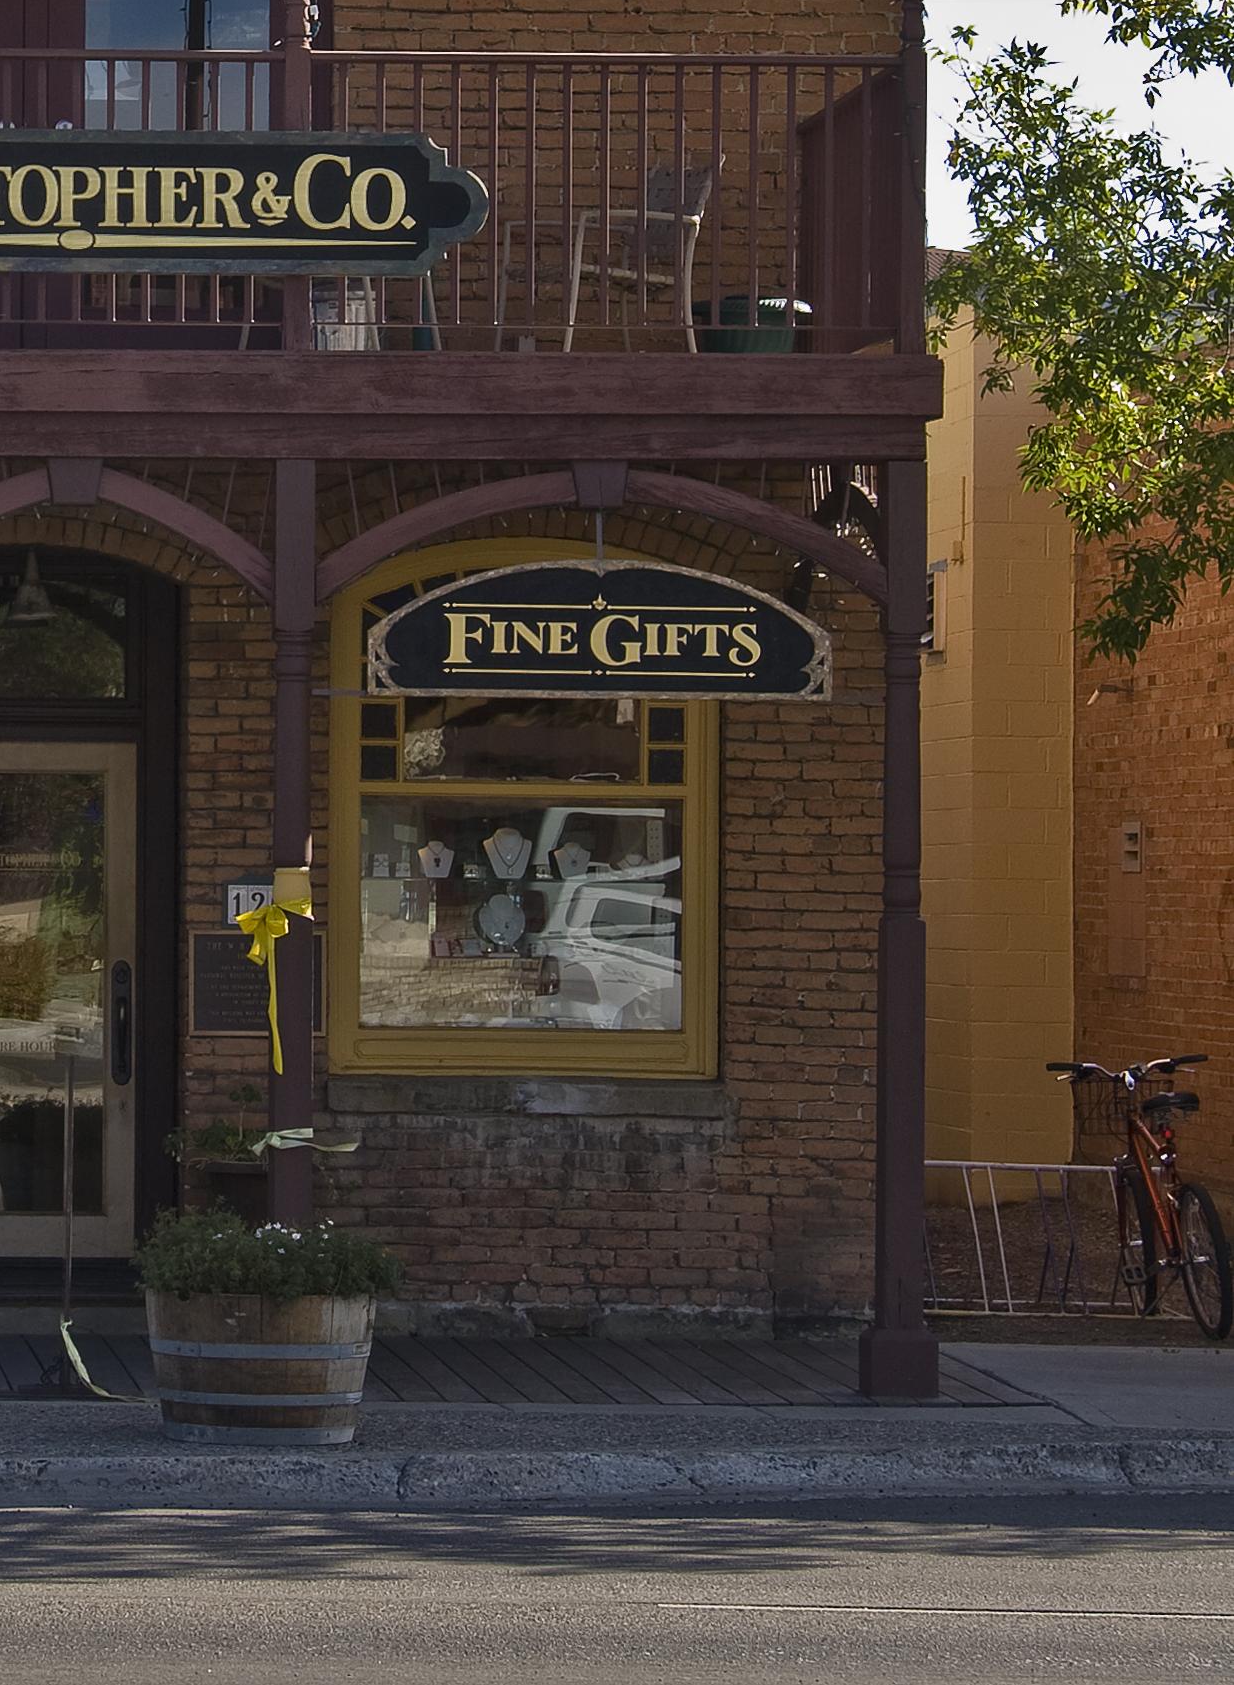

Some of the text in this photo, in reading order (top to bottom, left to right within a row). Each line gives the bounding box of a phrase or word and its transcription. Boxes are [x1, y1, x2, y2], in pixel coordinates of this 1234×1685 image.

[442, 612, 762, 667] FINE GIFTS
[232, 891, 273, 918] 12
[20, 1040, 60, 1052] HOUR
